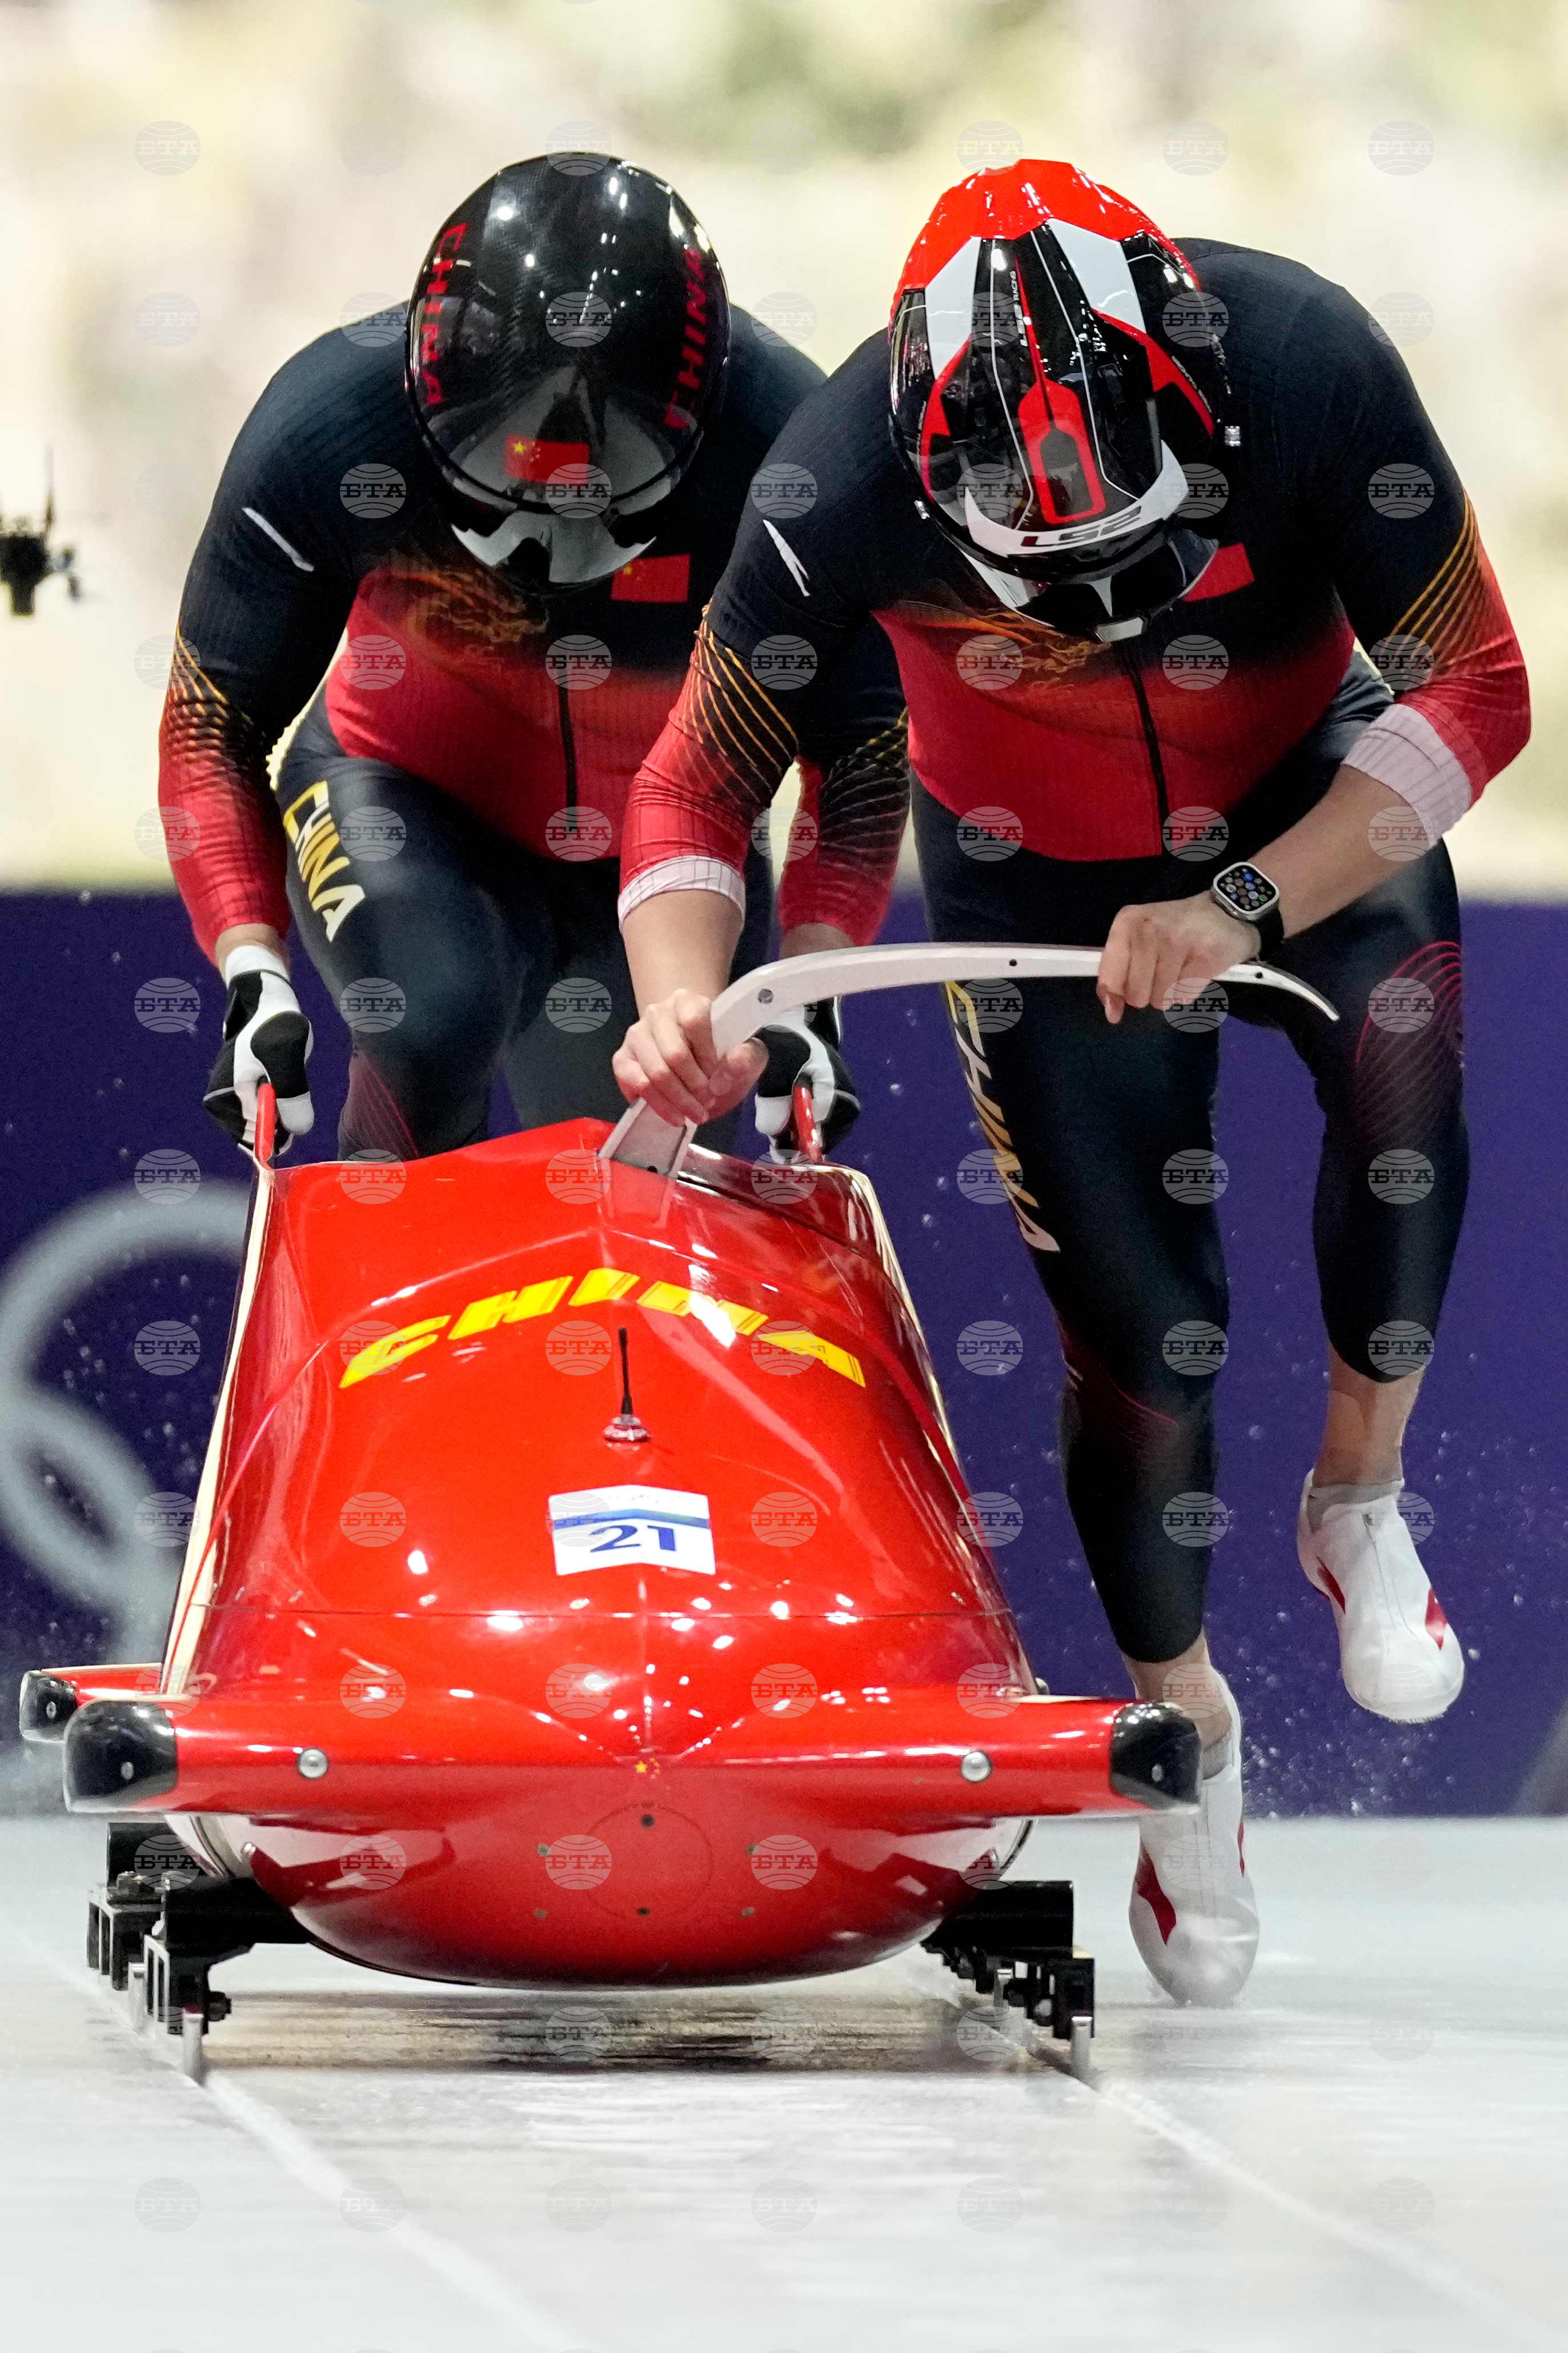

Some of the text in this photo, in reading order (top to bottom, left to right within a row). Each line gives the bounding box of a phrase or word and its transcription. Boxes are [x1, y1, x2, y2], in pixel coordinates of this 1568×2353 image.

[422, 223, 467, 405] CHINA
[664, 247, 707, 429] CHINA
[1020, 505, 1142, 547] LS2
[283, 781, 366, 942] CHINA
[945, 981, 1061, 1253] CHINA
[339, 1268, 865, 1388] CHINA
[589, 1524, 677, 1553] 21
